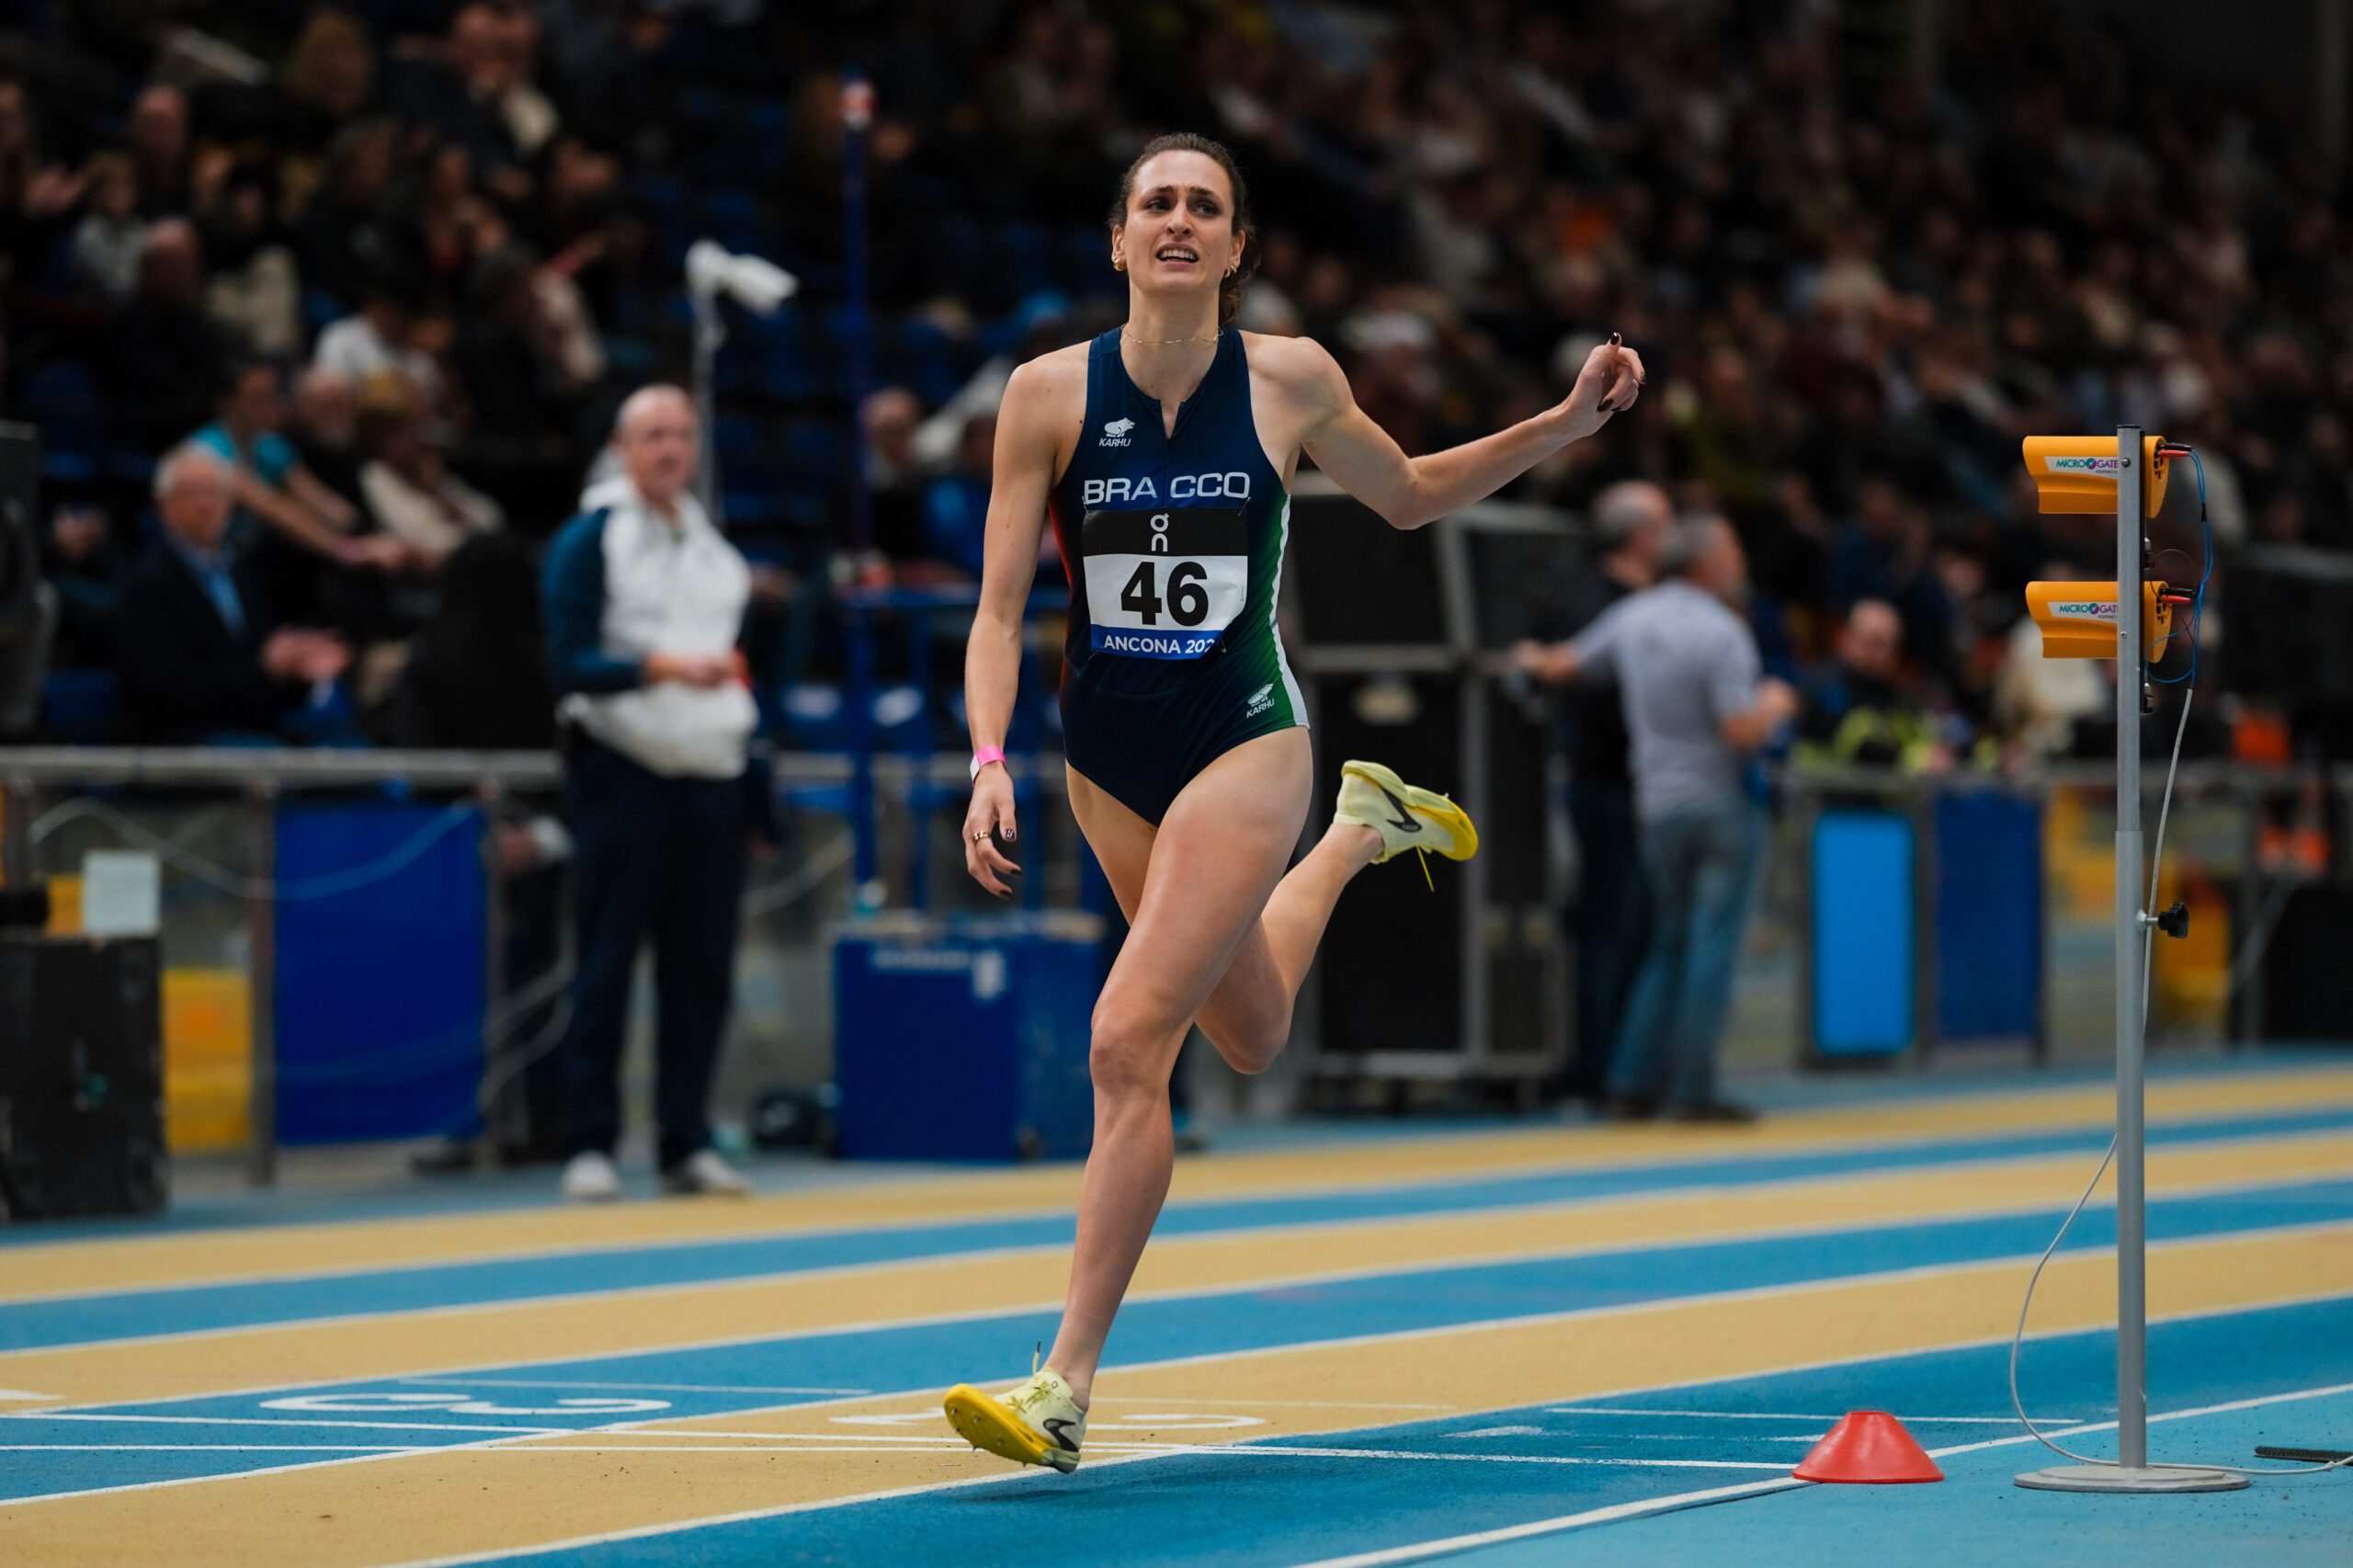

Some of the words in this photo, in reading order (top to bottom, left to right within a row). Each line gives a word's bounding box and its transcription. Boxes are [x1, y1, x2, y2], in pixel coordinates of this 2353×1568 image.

[1098, 437, 1131, 448] KARHU
[1120, 561, 1210, 627] 46
[1104, 634, 1182, 654] ANCONA
[1245, 698, 1276, 719] KARHU
